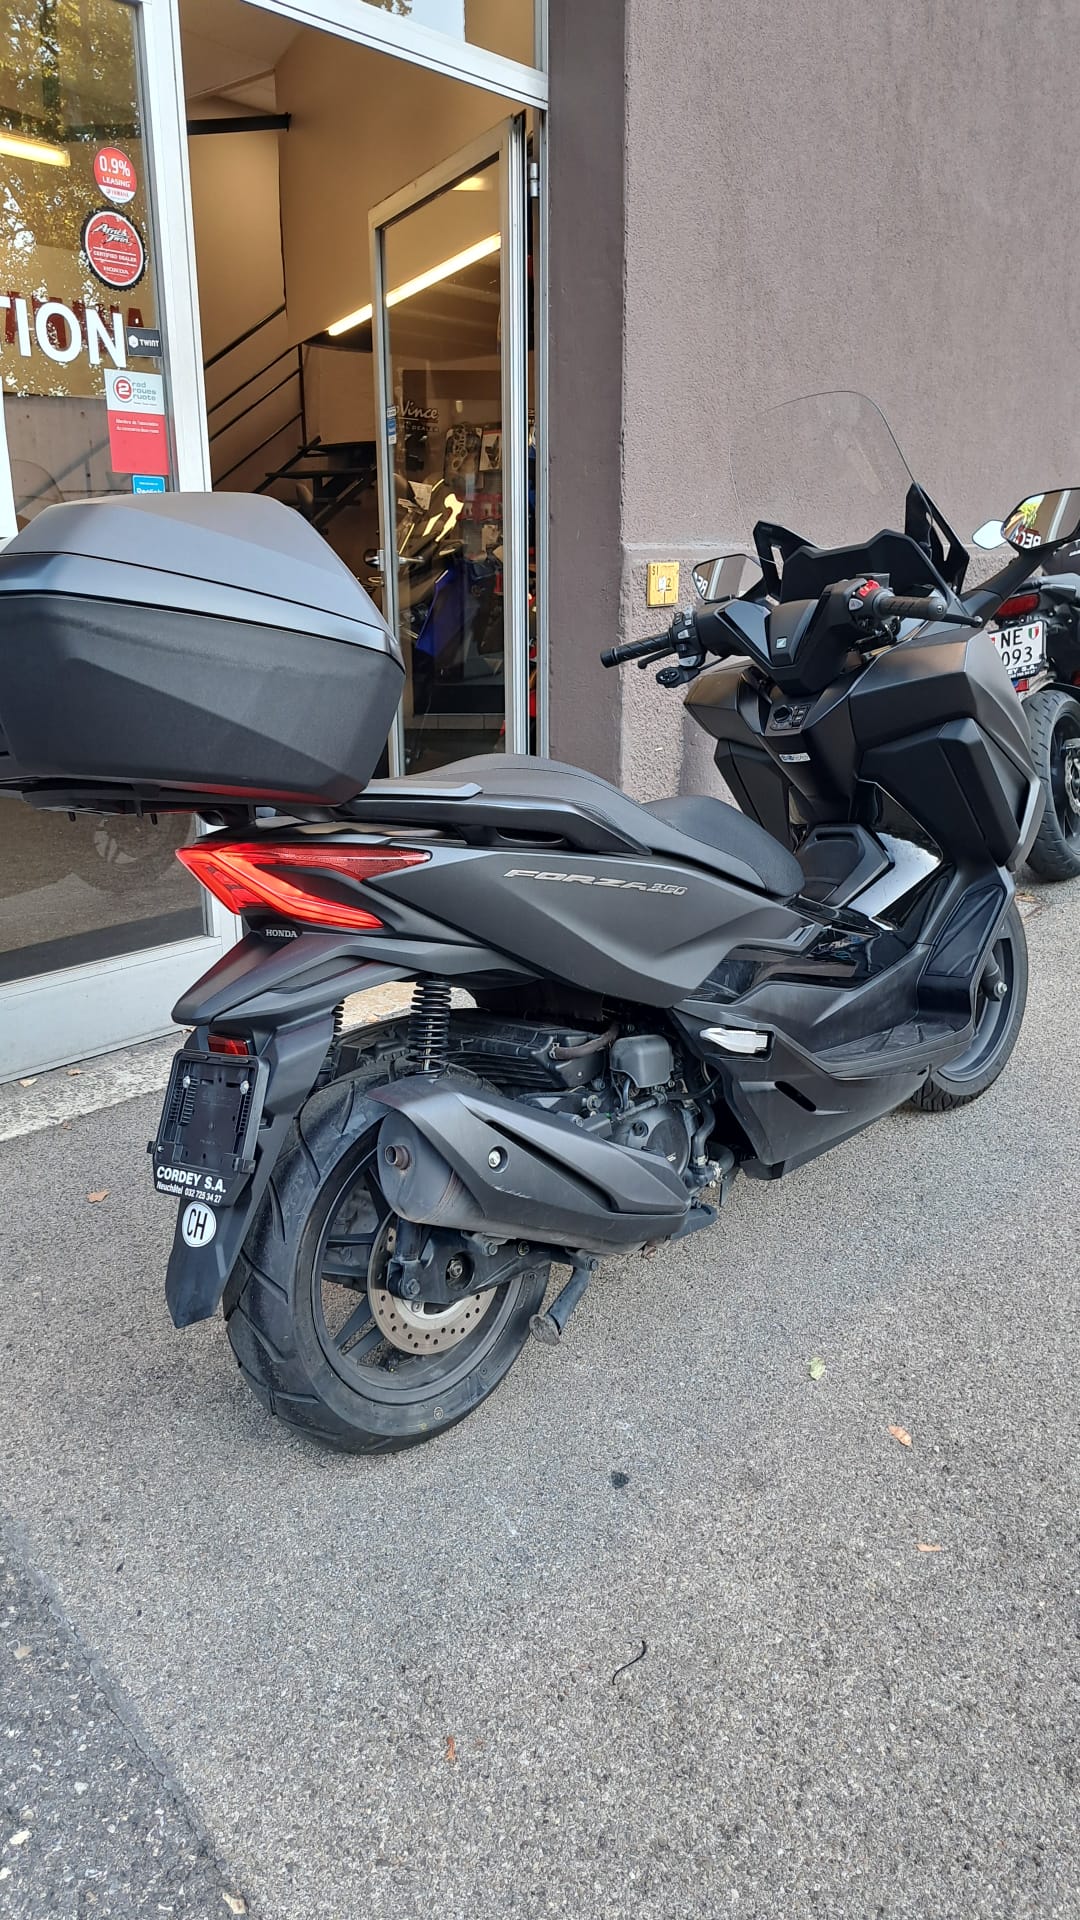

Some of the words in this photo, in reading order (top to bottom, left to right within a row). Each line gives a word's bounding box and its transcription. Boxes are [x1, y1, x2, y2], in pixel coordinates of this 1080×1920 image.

[99, 155, 131, 177] 0.9%
[102, 176, 131, 188] LEASING
[103, 266, 129, 275] HONDA
[0, 295, 126, 368] ION
[139, 339, 159, 347] TWINT
[1001, 628, 1023, 649] NE
[1002, 646, 1032, 666] 093
[503, 868, 647, 891] FORZA
[646, 882, 688, 896] 350
[265, 928, 298, 938] HONDA
[156, 1166, 202, 1186] CORDEY
[204, 1176, 226, 1193] S.A.
[156, 1180, 183, 1194] Neuchâtel
[184, 1187, 195, 1198] 032
[196, 1190, 205, 1200] 725
[206, 1193, 213, 1202] 34
[213, 1194, 222, 1203] 27
[187, 1208, 208, 1240] CH
